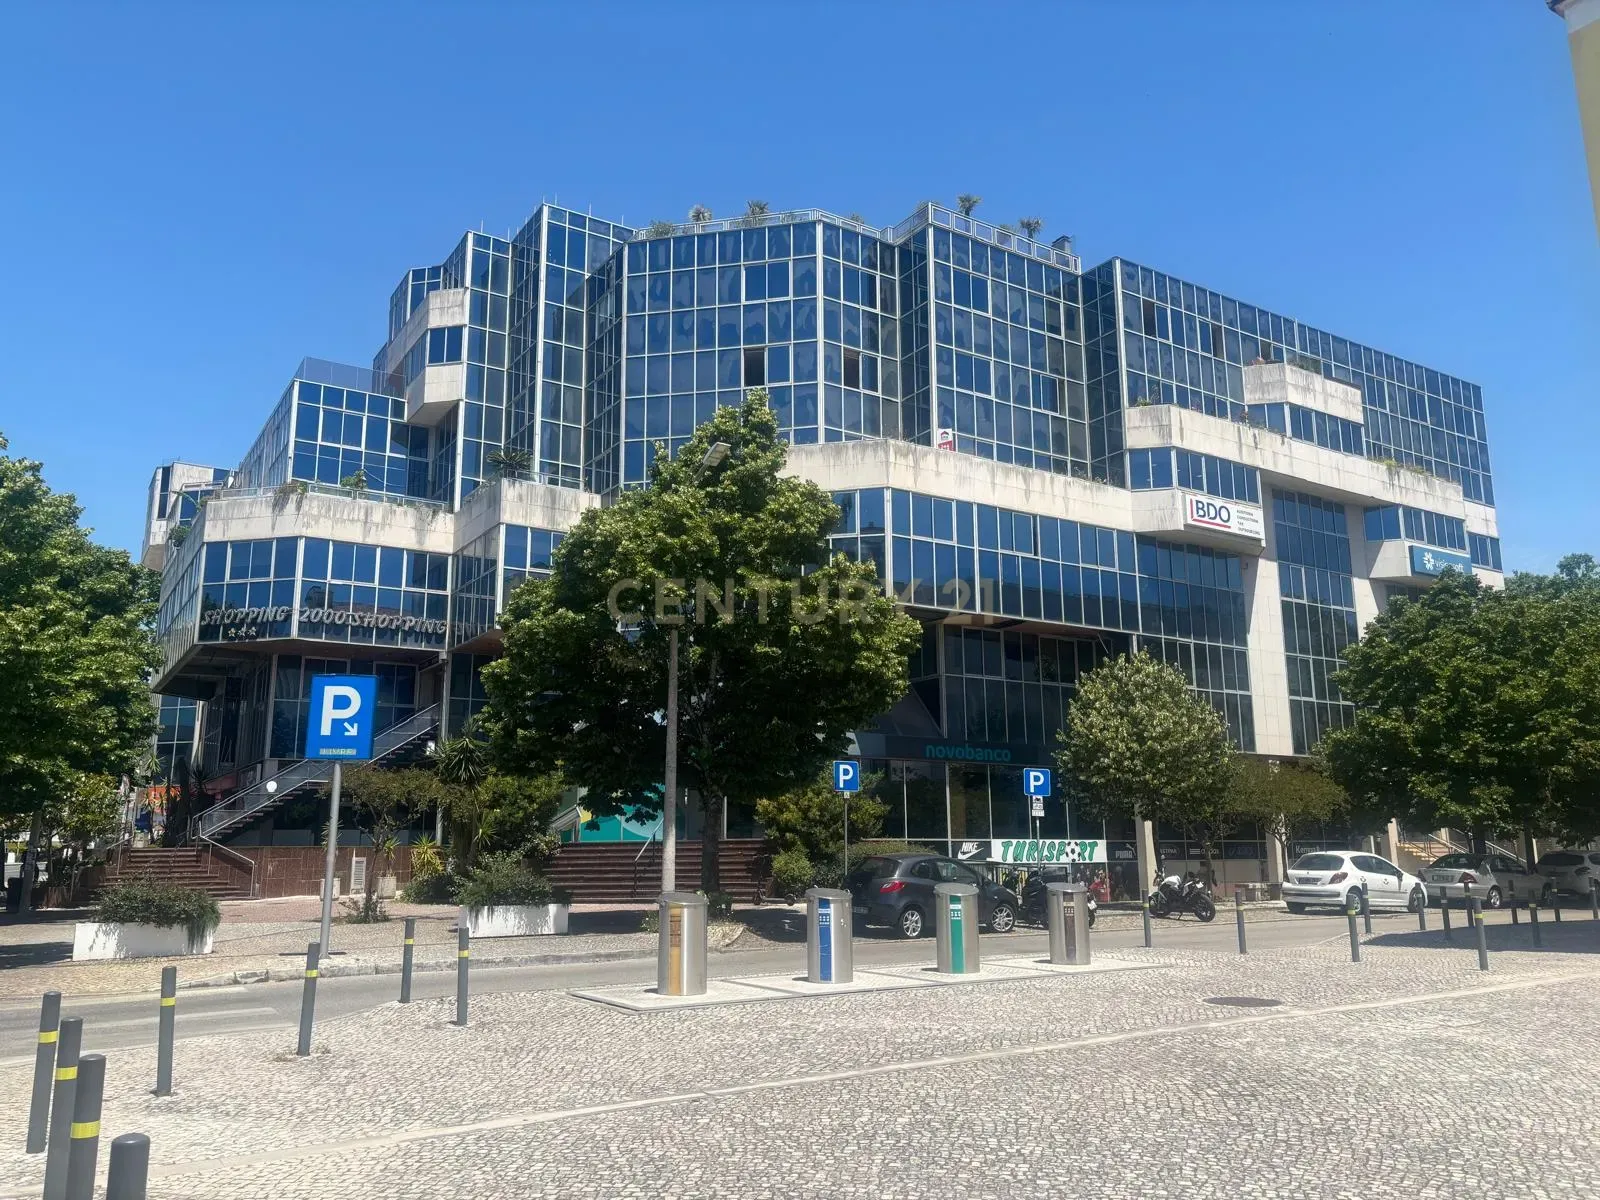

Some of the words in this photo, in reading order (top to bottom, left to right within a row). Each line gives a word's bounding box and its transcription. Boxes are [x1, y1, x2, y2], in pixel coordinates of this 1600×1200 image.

[1195, 499, 1231, 523] BDO
[201, 605, 289, 626] SHOPPING
[299, 607, 347, 625] 2000
[350, 611, 447, 634] SHOPPING
[320, 685, 362, 736] P
[925, 744, 1012, 762] novobanco
[839, 764, 853, 788] P
[1029, 771, 1045, 793] P
[961, 841, 979, 852] NIKE
[1115, 850, 1133, 859] PUMA
